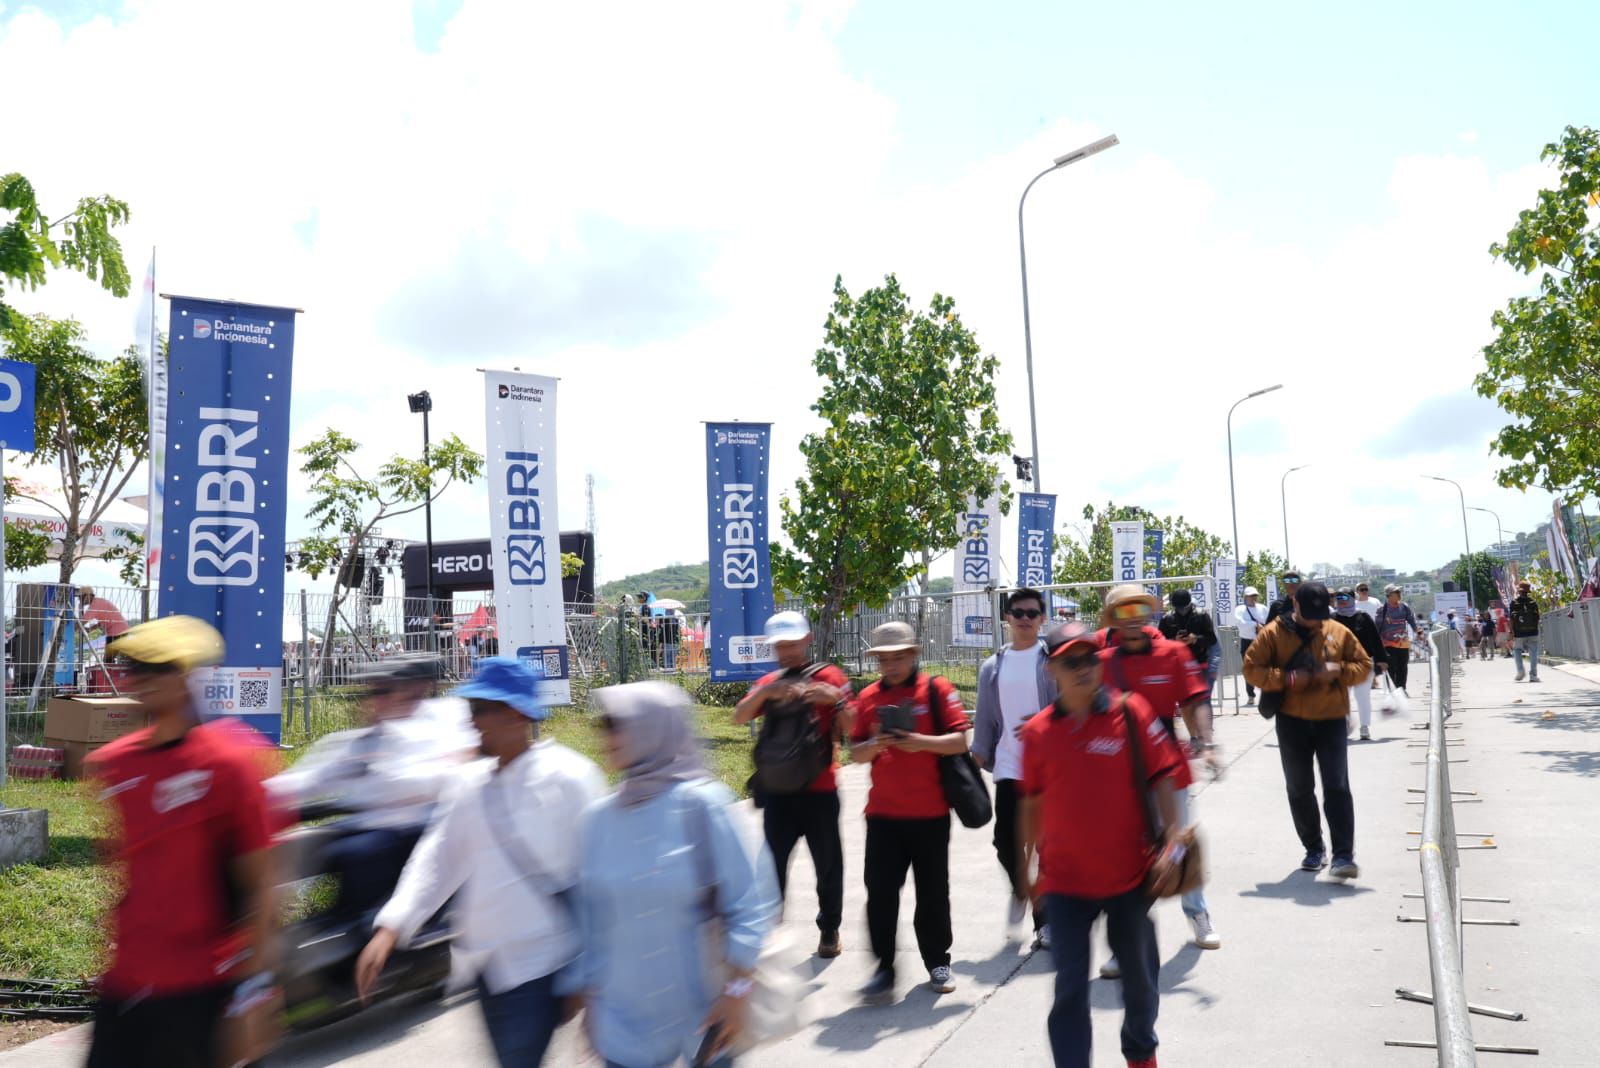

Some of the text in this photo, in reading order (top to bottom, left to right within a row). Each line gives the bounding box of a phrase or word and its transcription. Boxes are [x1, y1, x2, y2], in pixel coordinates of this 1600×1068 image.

[213, 330, 268, 345] Indonesia
[214, 319, 272, 335] Danantara
[195, 406, 259, 514] BRI
[505, 451, 541, 531] BRI
[723, 483, 754, 546] BRI
[966, 513, 989, 555] BRI
[1027, 529, 1045, 568] BRI
[431, 554, 483, 573] HERO
[1120, 551, 1136, 581] BRI
[1218, 578, 1230, 601] BRI
[738, 646, 753, 655] BRI
[204, 685, 234, 699] BRI
